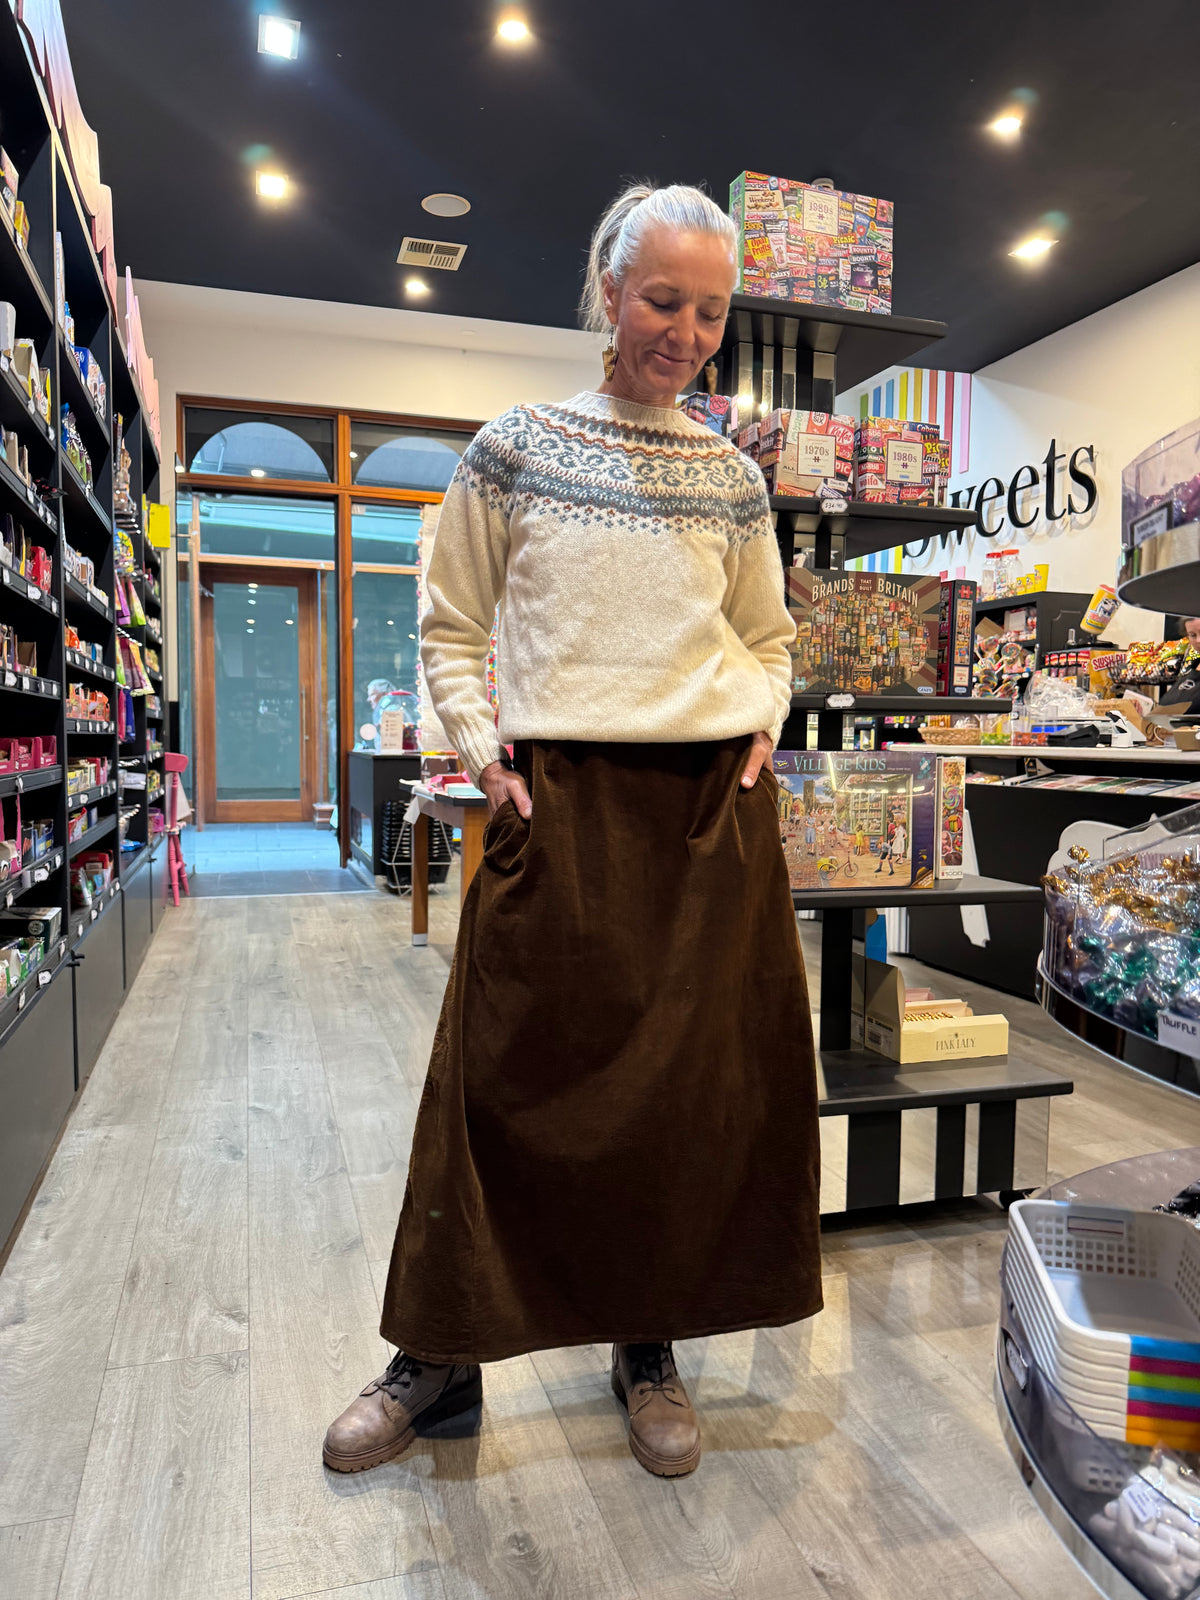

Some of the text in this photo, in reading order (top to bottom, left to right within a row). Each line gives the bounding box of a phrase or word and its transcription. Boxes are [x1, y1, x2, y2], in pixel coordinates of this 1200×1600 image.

[808, 201, 833, 214] 1980s
[852, 246, 874, 254] BOUNTY
[852, 255, 875, 263] BOUNTY
[804, 445, 830, 456] 1970s
[893, 451, 917, 463] 1980s
[812, 578, 855, 602] BRANDS
[877, 578, 918, 608] BRITAIN
[793, 755, 852, 773] VILLGE
[855, 756, 887, 772] KIDS
[1161, 1014, 1197, 1036] TRUFFLE
[936, 1037, 977, 1051] PINK LADY
